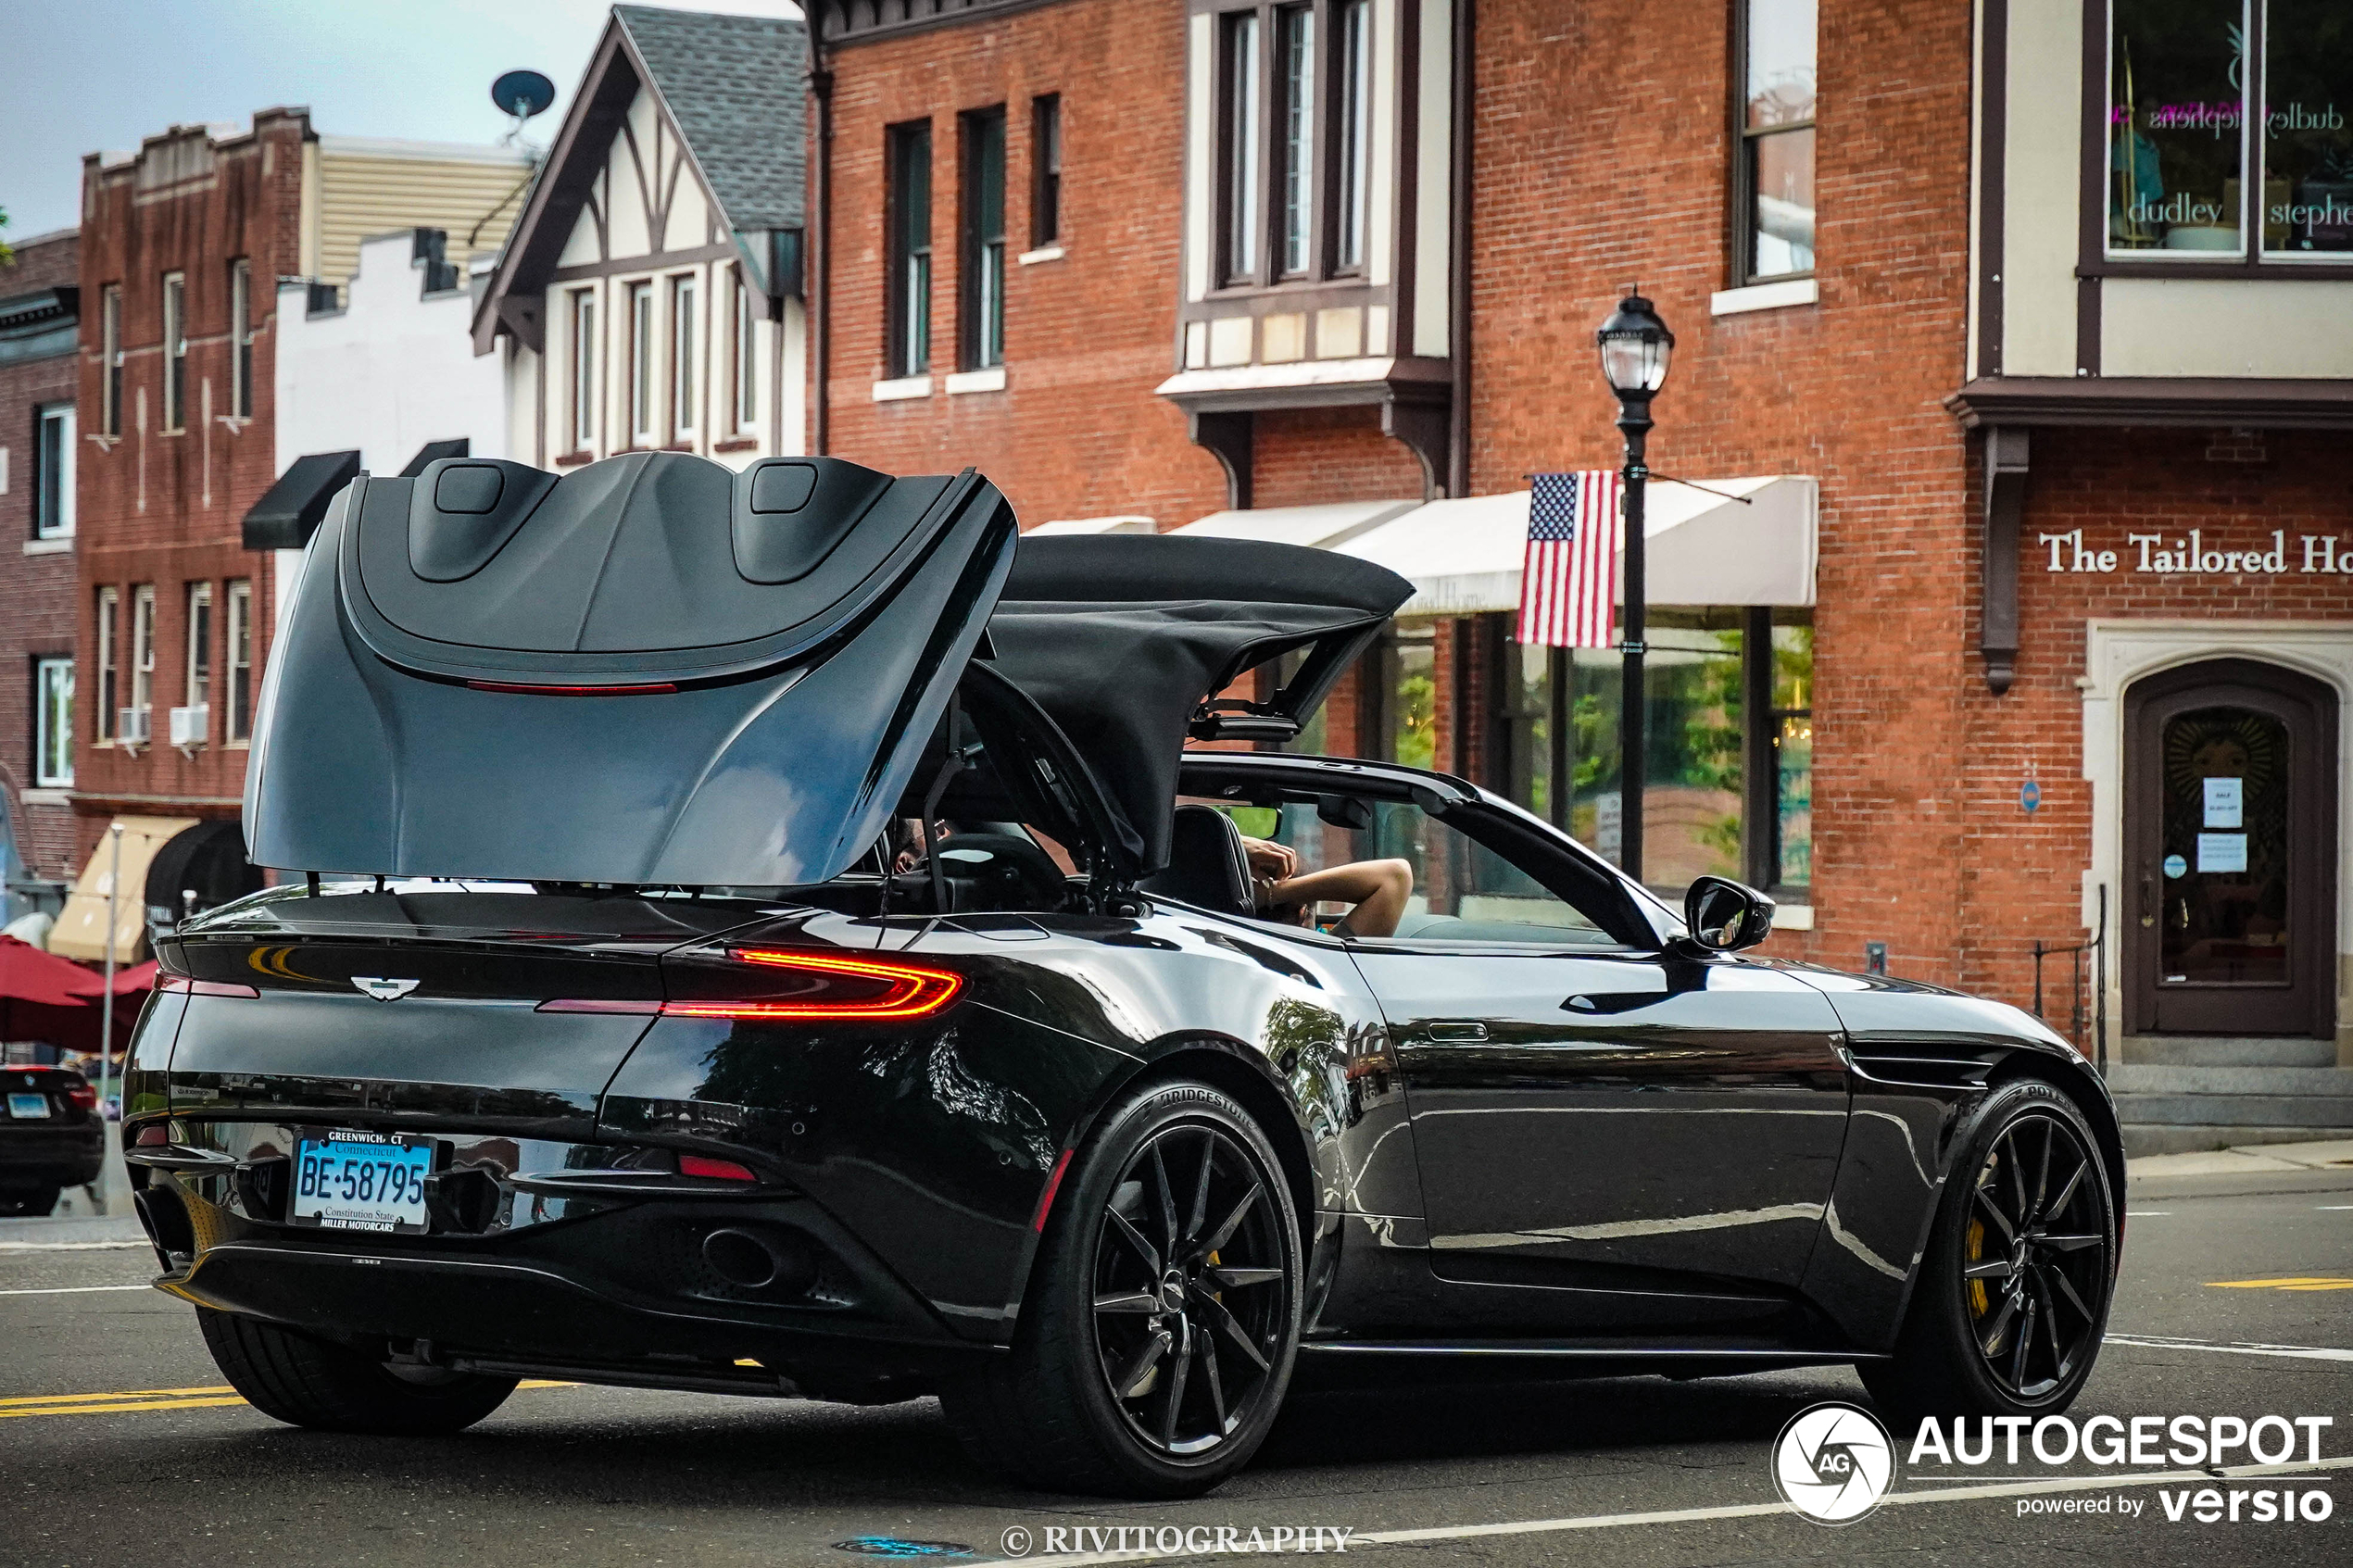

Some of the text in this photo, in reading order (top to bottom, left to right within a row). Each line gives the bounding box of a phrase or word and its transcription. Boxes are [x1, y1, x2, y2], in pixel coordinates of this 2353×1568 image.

[2128, 191, 2222, 228] dudley
[2039, 528, 2118, 573] The
[2129, 528, 2288, 573] Tailored
[329, 1132, 403, 1145] GREENWICH, CT
[335, 1144, 396, 1157] Connecticut
[325, 1206, 395, 1221] Constitution State
[320, 1218, 395, 1232] MILLER MOTORCARS
